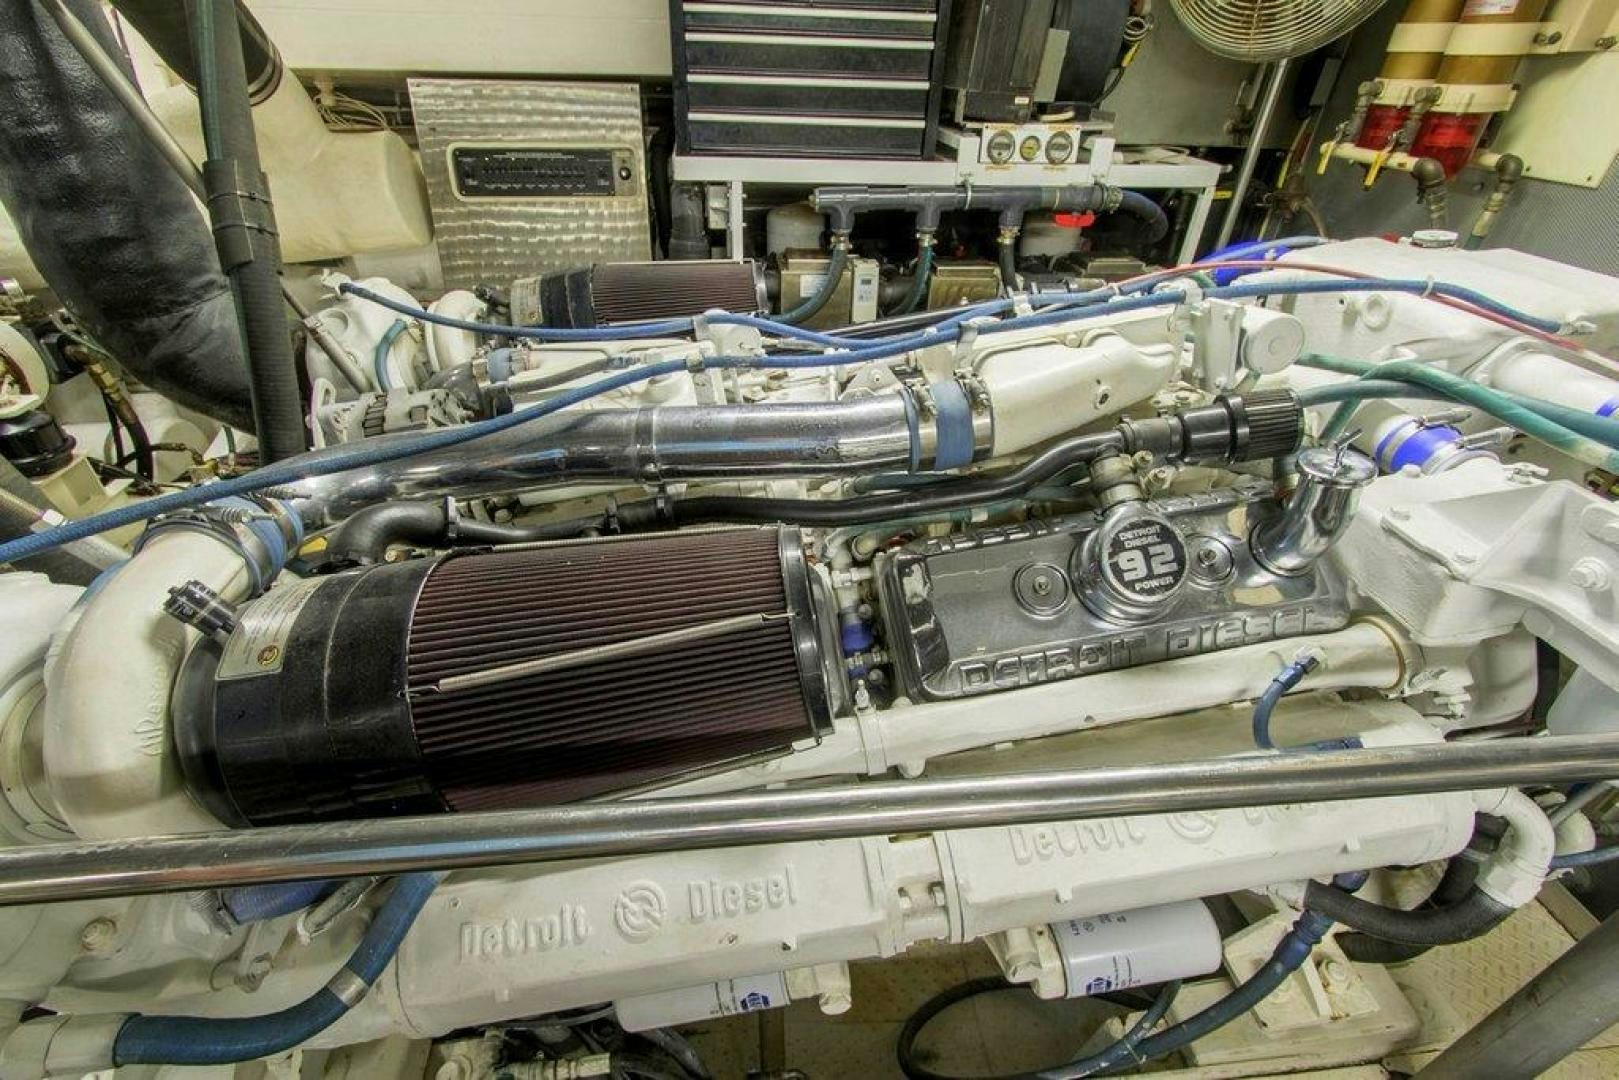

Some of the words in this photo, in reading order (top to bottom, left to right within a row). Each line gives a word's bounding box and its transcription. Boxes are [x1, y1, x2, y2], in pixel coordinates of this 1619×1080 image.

[1119, 525, 1161, 541] DETROIT
[1124, 535, 1160, 549] DIESEL
[1118, 543, 1179, 581] 92
[1134, 576, 1175, 591] POWER
[960, 632, 1147, 690] DETROIT
[1167, 606, 1318, 657] DIESEL
[460, 900, 593, 960] Detroit
[688, 862, 797, 920] Diesel
